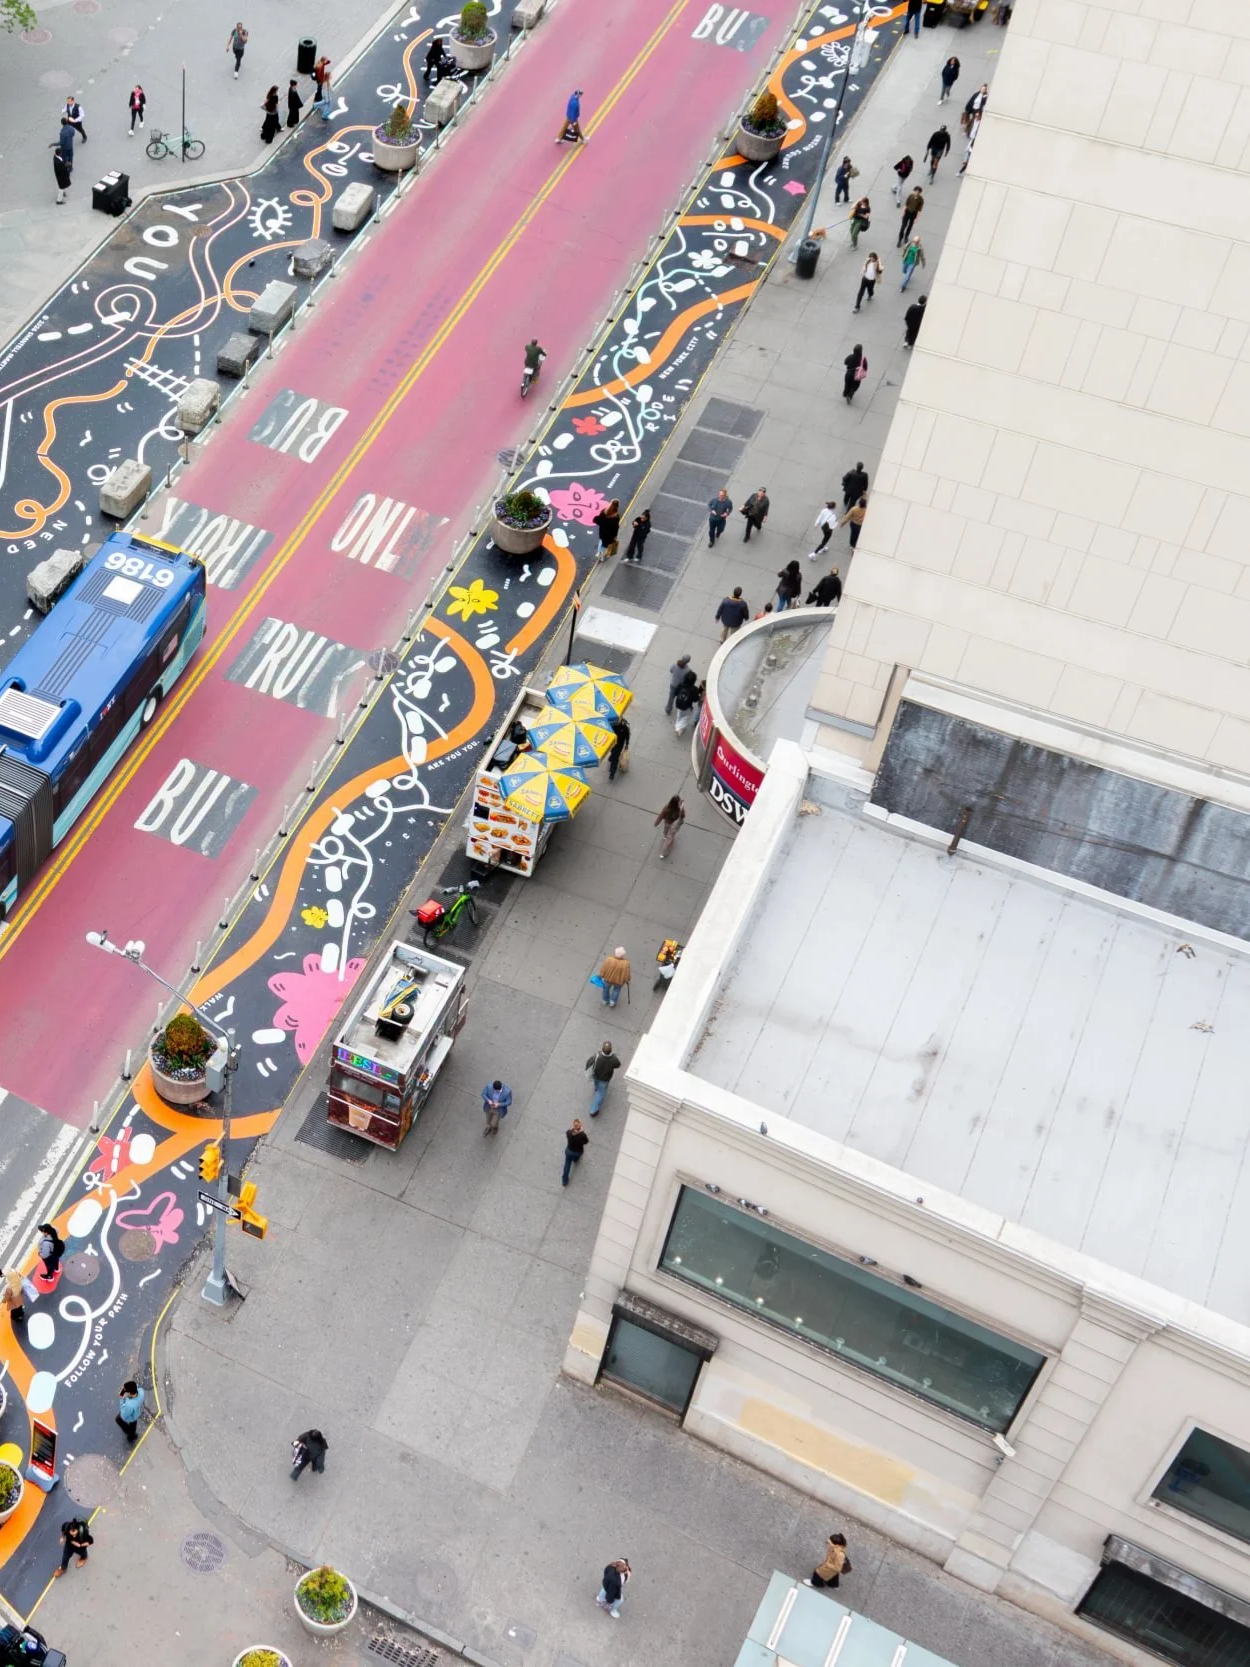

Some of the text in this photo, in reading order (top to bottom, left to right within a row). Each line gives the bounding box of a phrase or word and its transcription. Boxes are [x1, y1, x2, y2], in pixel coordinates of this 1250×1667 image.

[124, 203, 203, 281] YOU
[658, 336, 699, 379] NEW YORK CITY
[7, 519, 68, 555] NEED
[104, 552, 175, 588] 6186
[427, 759, 446, 772] ARE
[446, 749, 462, 763] YOU
[508, 800, 540, 820] SABRETT
[200, 992, 224, 1012] WALK
[64, 1292, 130, 1389] FOLLOW YOUR PATH
